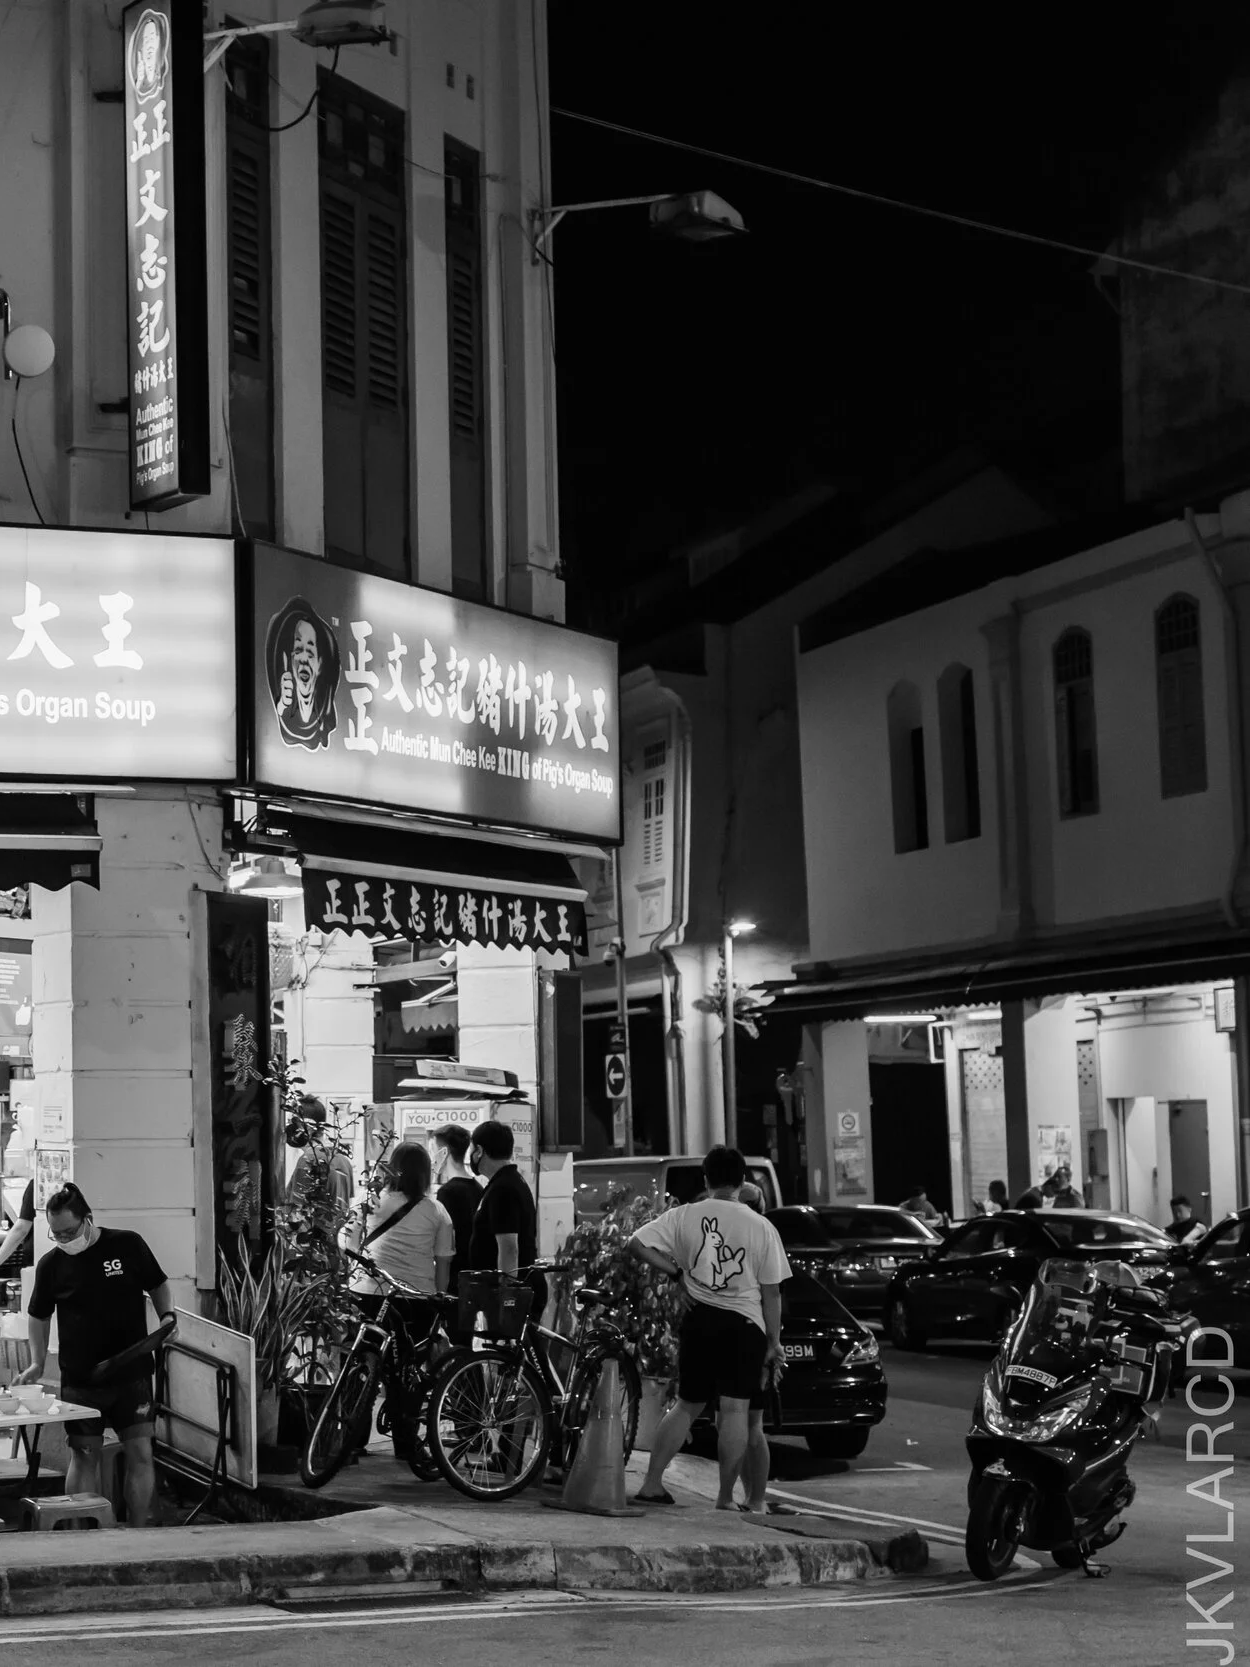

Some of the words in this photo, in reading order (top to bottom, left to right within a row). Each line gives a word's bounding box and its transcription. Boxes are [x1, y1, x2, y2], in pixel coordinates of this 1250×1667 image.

[135, 395, 174, 426] Authentic
[135, 428, 148, 441] Mun
[148, 422, 163, 437] Chee
[162, 417, 174, 431] Kee
[136, 436, 163, 467] KING
[164, 434, 174, 455] of
[147, 466, 162, 482] Organ
[161, 461, 175, 476] Soup
[16, 689, 88, 724] Organ
[95, 692, 156, 727] Soup
[381, 726, 429, 760] Authentic
[429, 736, 451, 763] Mun
[452, 740, 477, 768] Chee
[478, 745, 496, 771] Kee
[497, 746, 530, 780] KING
[532, 756, 543, 780] of
[542, 758, 564, 789] Pig's
[564, 763, 591, 794] Organ
[591, 768, 614, 799] Soup
[103, 1258, 122, 1272] SG
[784, 1344, 814, 1358] 99M
